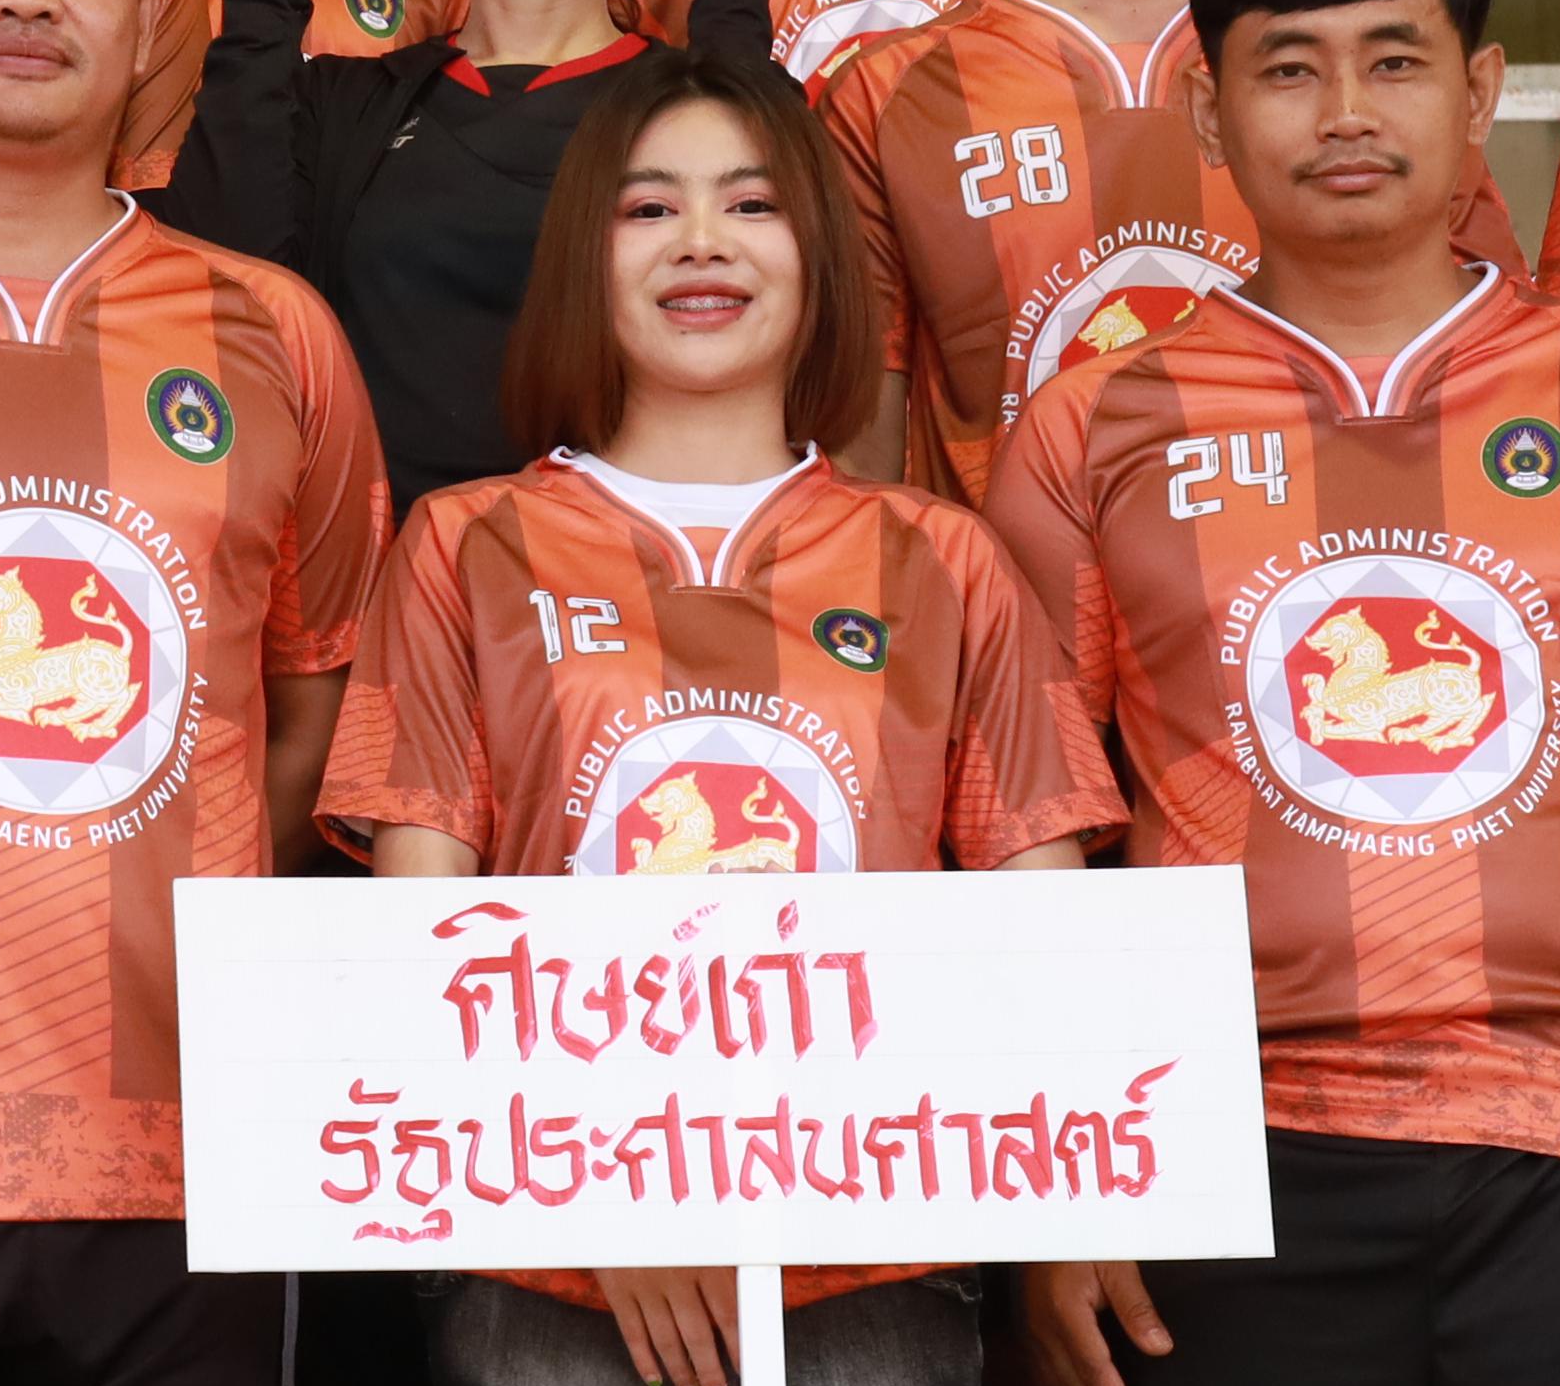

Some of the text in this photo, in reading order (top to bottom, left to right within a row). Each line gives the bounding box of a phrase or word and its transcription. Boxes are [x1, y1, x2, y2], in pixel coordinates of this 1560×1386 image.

[953, 123, 1071, 220] 28
[1006, 262, 1073, 361] PUBLIC
[1165, 430, 1291, 521] 24
[528, 587, 627, 665] 12
[1221, 527, 1560, 666] PUBLIC ADMINISTRATION
[89, 813, 146, 848] PHET
[142, 671, 210, 822] UNIVERSITY
[565, 686, 868, 820] PUBLIC ADMINISTRATION
[1280, 801, 1436, 857] KAMPHAENG
[1452, 811, 1517, 850] PHET
[431, 899, 880, 1064] ศิษย์เก่า
[318, 1055, 1184, 1245] รัฐประศาสนศาสตร์
